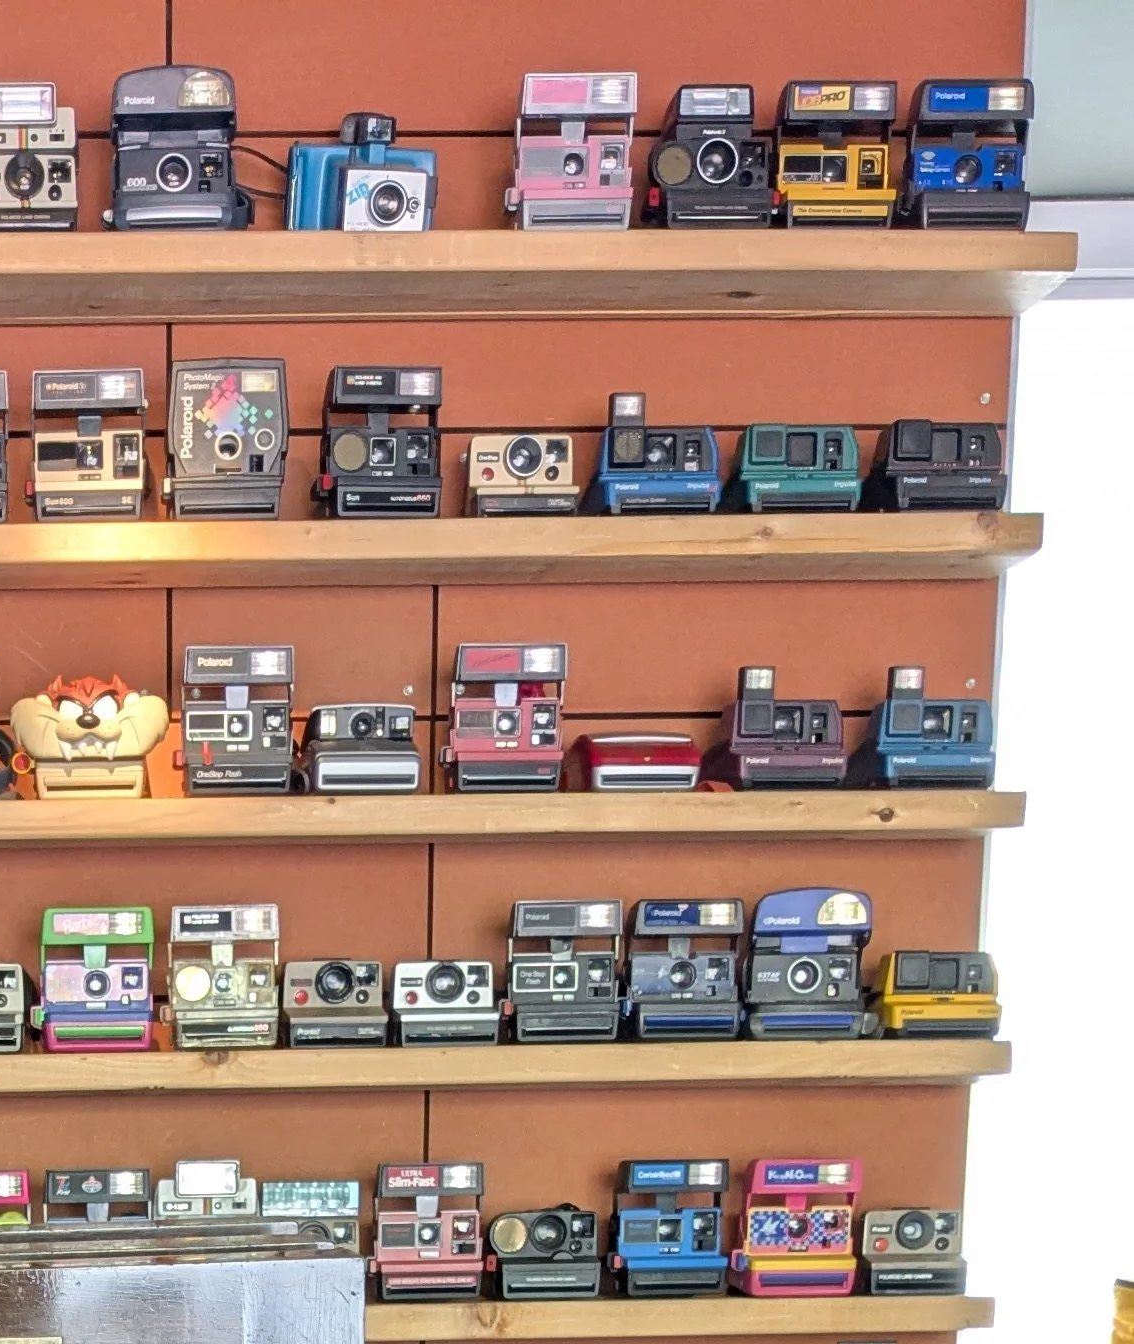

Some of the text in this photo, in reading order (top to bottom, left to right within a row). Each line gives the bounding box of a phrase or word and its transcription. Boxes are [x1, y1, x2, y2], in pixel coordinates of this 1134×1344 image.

[124, 96, 155, 105] Polaroid
[936, 92, 965, 100] Polaroid
[52, 382, 78, 391] Polaroid
[184, 382, 208, 391] System
[180, 396, 193, 459] Polaroid
[615, 483, 639, 491] Polaroid
[346, 493, 360, 502] Sun
[198, 657, 232, 667] Polaroid
[746, 757, 769, 765] Polaroid
[525, 913, 550, 921] Polaroid
[768, 916, 800, 925] Polaroid
[389, 1176, 436, 1188] Slim-Fast
